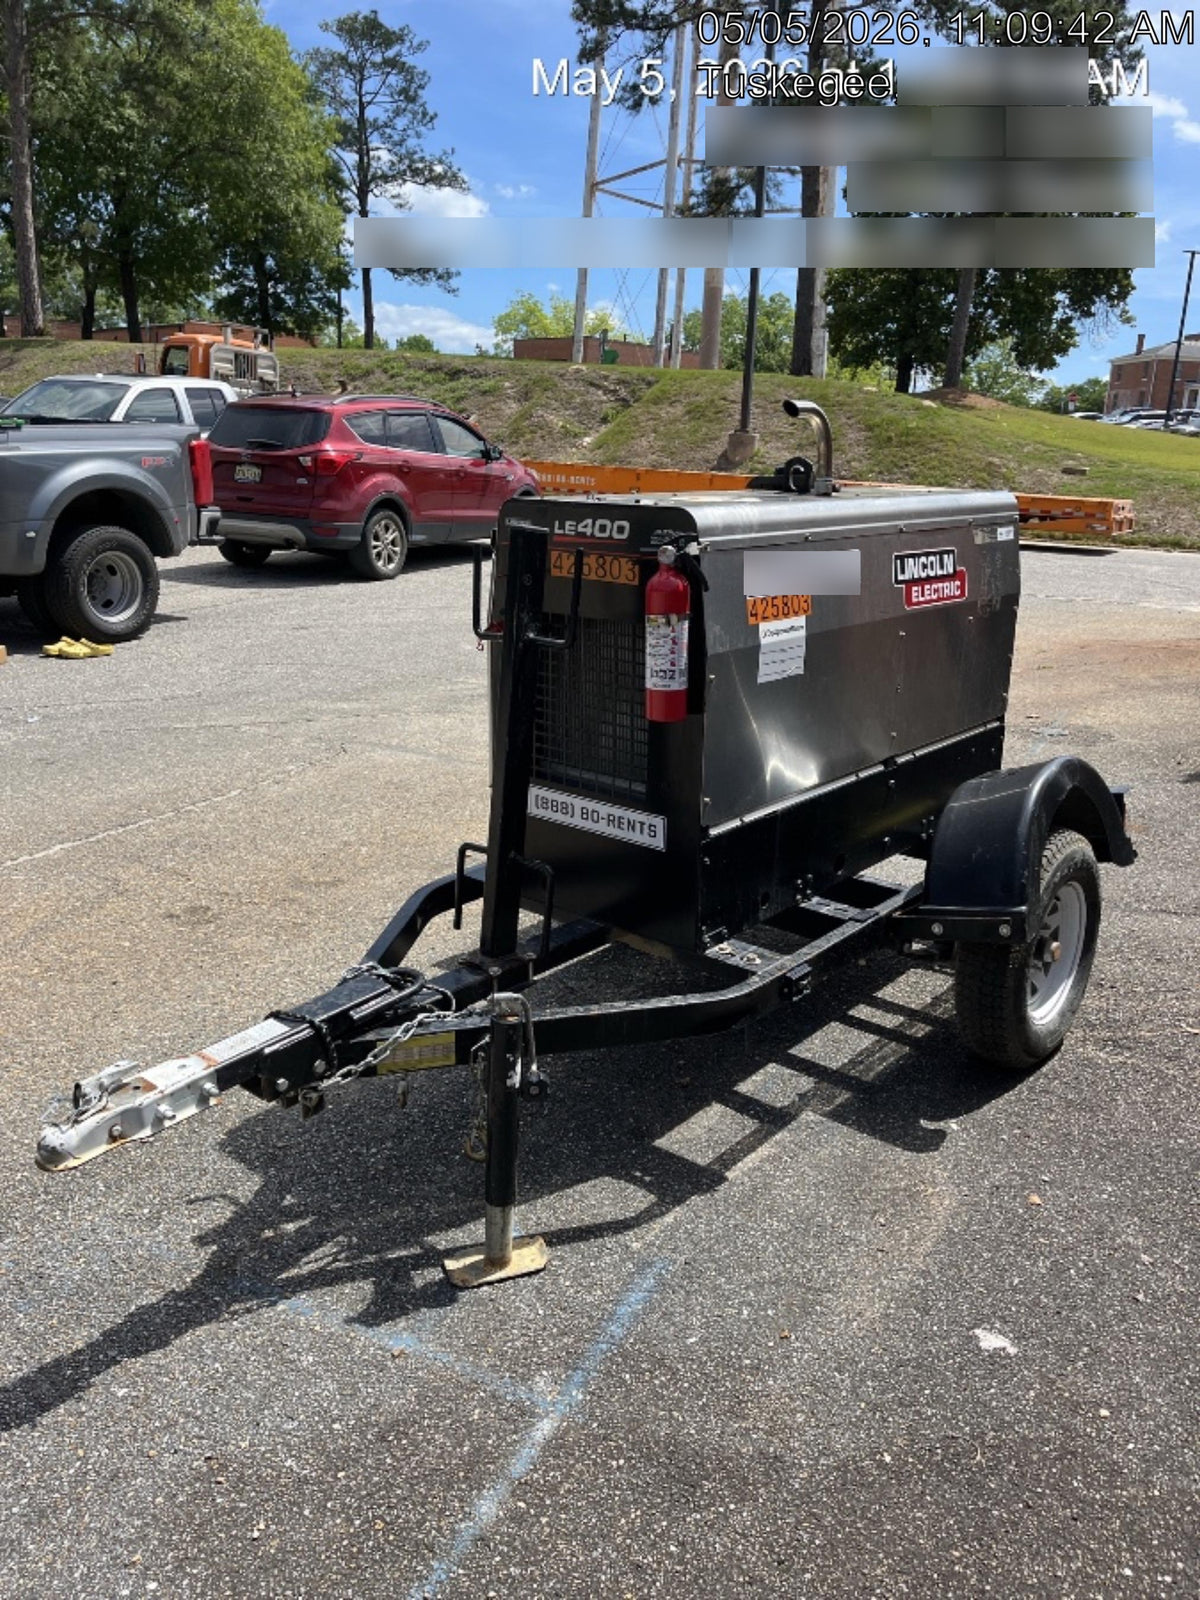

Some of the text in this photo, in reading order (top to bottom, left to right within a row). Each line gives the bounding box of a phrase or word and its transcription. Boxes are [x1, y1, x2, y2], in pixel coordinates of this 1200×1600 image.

[553, 518, 631, 540] LE400
[896, 553, 954, 580] LINCOLN
[911, 580, 961, 603] ELECTRIC
[749, 594, 810, 622] 425803
[534, 794, 575, 819] (888)
